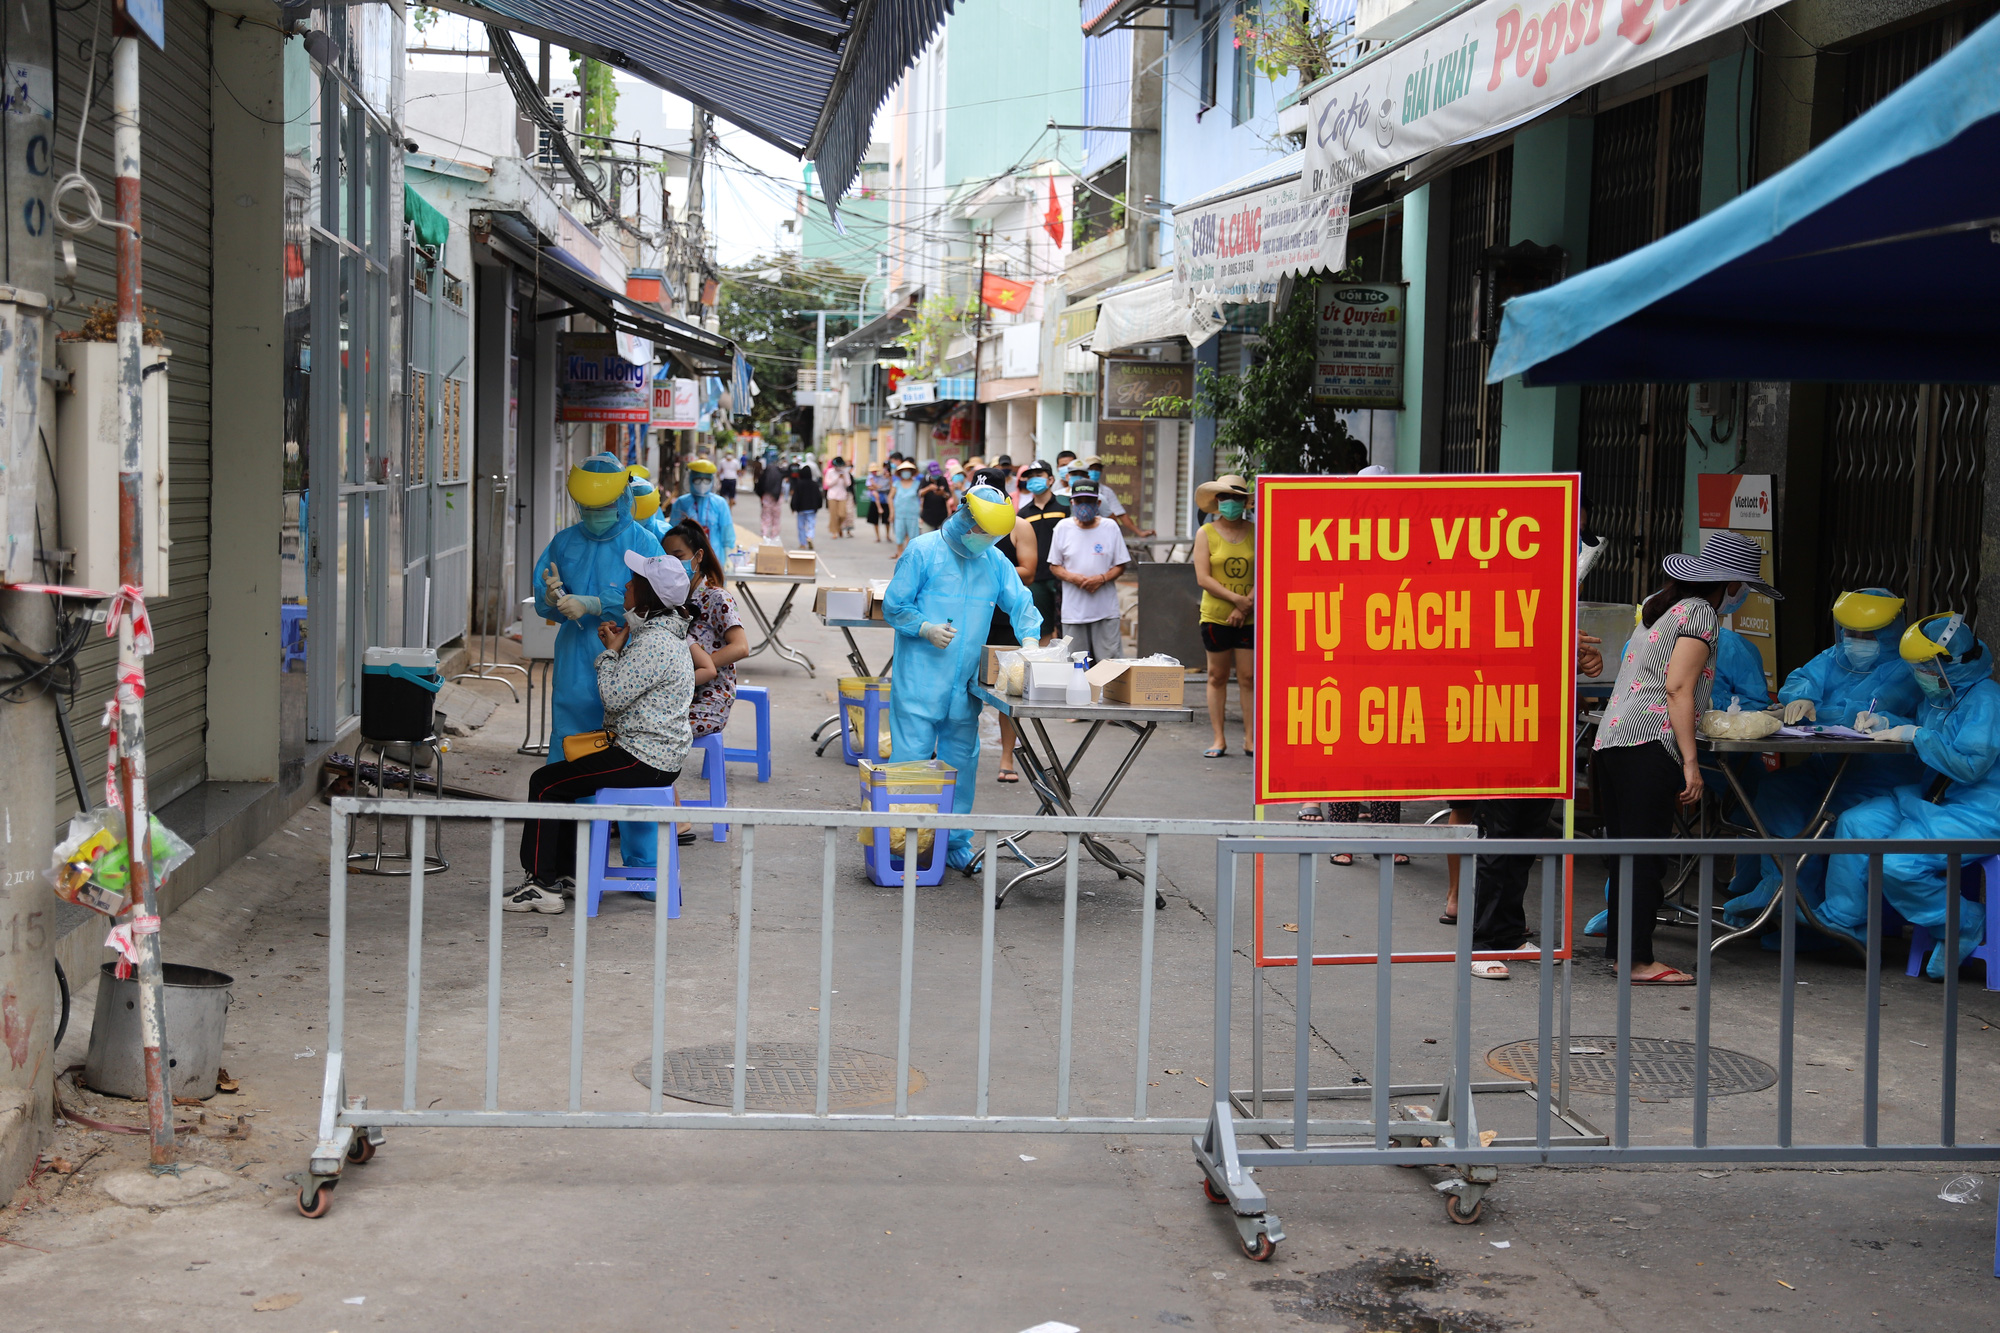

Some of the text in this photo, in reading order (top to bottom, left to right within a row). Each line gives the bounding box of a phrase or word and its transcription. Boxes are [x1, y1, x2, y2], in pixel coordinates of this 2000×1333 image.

[1487, 0, 1601, 91] Pepsi
[1402, 33, 1479, 126] GIẢI KHÁT
[1317, 84, 1371, 151] Café
[1192, 211, 1216, 257] CƠM
[1339, 289, 1384, 301] UỐN TÓC
[1342, 306, 1387, 326] Quyên
[569, 355, 599, 381] Kim
[1155, 366, 1183, 376] SALON
[1734, 495, 1759, 509] Vietlott
[1298, 518, 1410, 561] KHU
[1431, 508, 1541, 569] VỰC
[1287, 578, 1541, 661] TỰ CÁCH LY
[1740, 615, 1769, 631] JACKPOT 2
[1287, 670, 1539, 756] HỘ GIA ĐÌNH
